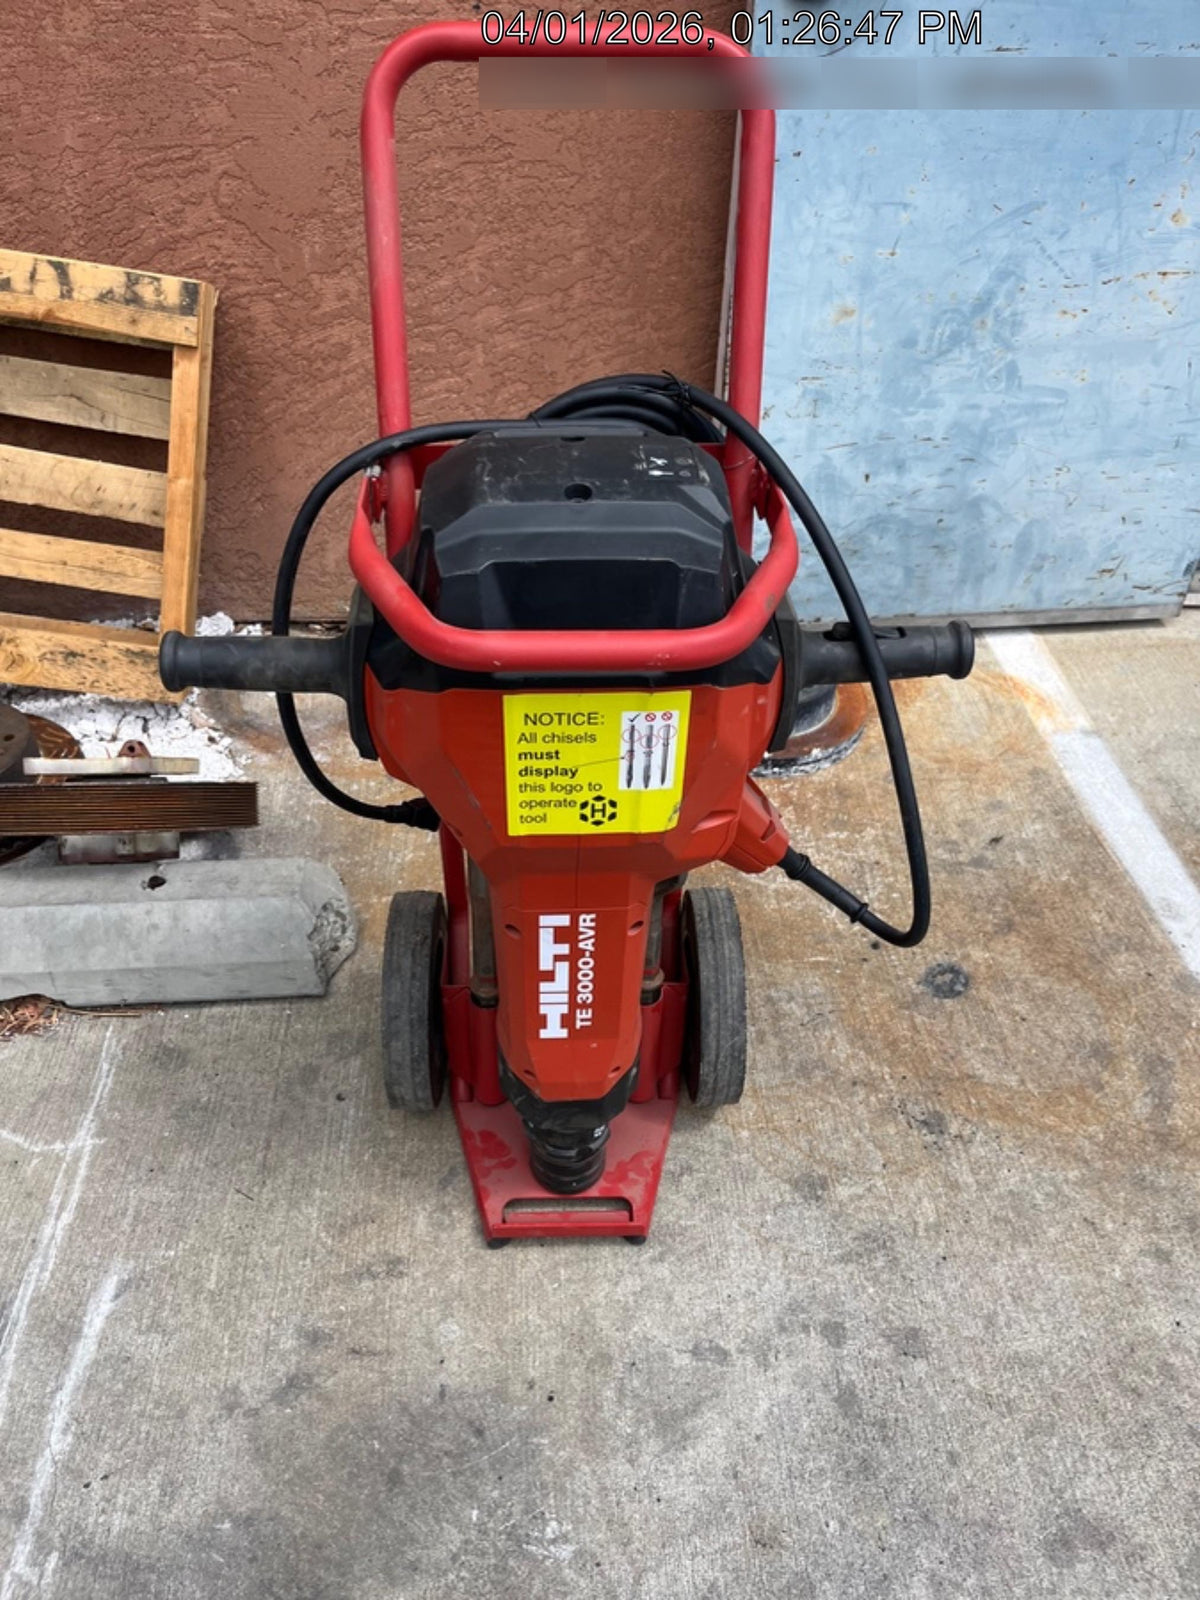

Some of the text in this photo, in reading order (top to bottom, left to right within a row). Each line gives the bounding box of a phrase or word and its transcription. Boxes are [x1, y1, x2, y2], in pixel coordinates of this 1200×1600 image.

[524, 712, 605, 726] NOTICE:
[517, 732, 597, 744] All chisels
[518, 750, 560, 760] must
[518, 766, 579, 779] display
[518, 781, 603, 795] this logo to
[519, 798, 577, 810] operate
[519, 813, 547, 823] tool
[539, 914, 570, 1039] HILTI
[575, 913, 597, 1030] TE 3000-AVR
